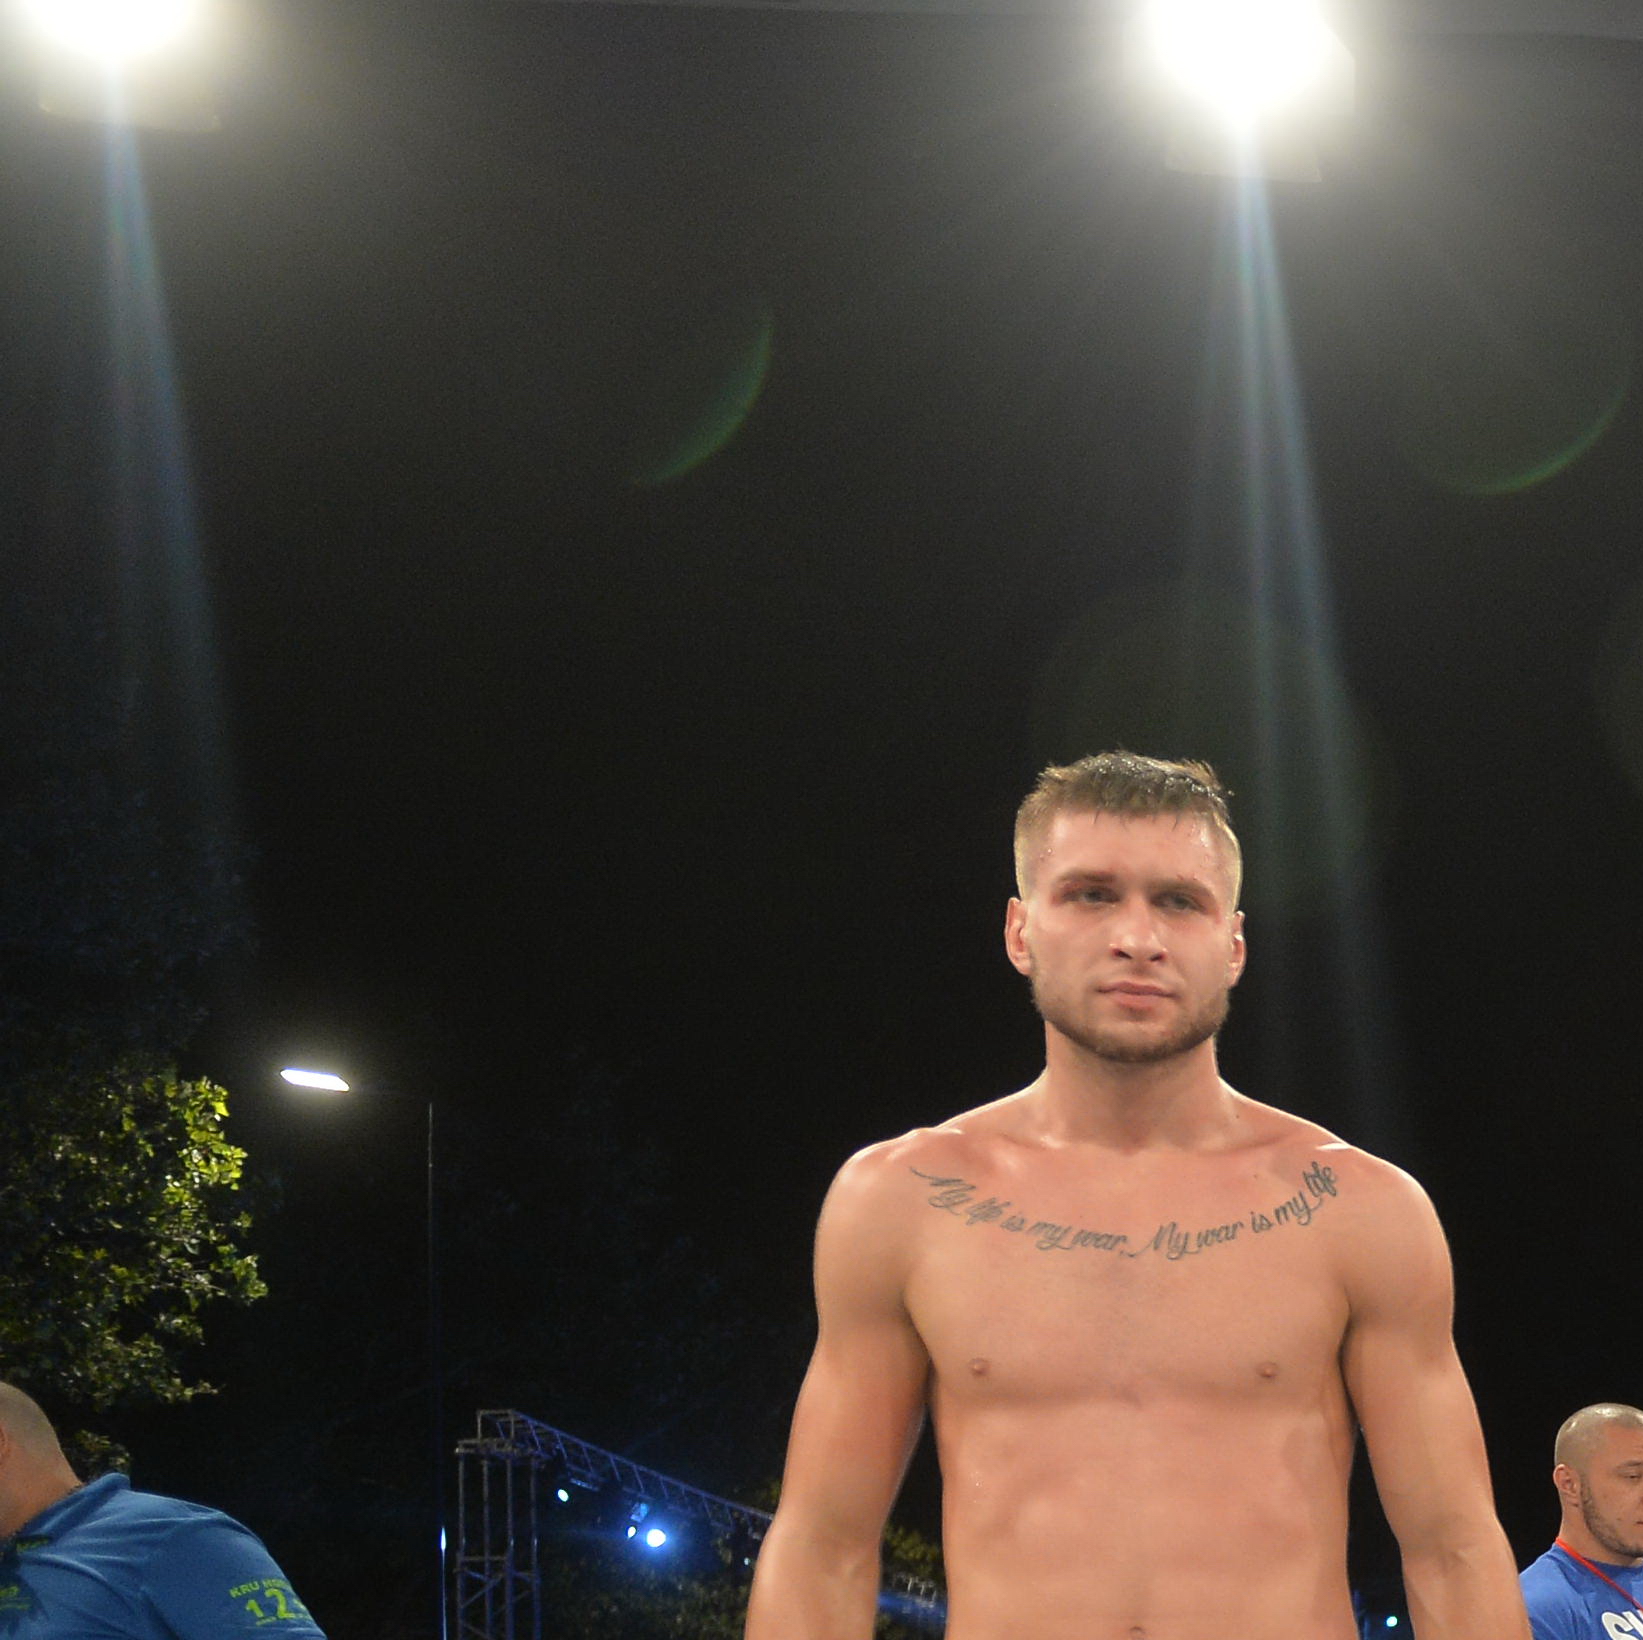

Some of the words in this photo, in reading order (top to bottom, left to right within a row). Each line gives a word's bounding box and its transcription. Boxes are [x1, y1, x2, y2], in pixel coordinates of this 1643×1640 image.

[1027, 1219, 1073, 1250] my
[1127, 1221, 1195, 1260] My
[1196, 1221, 1244, 1248] war
[1252, 1211, 1274, 1234] is
[1274, 1195, 1322, 1226] my
[1303, 1161, 1338, 1199] life
